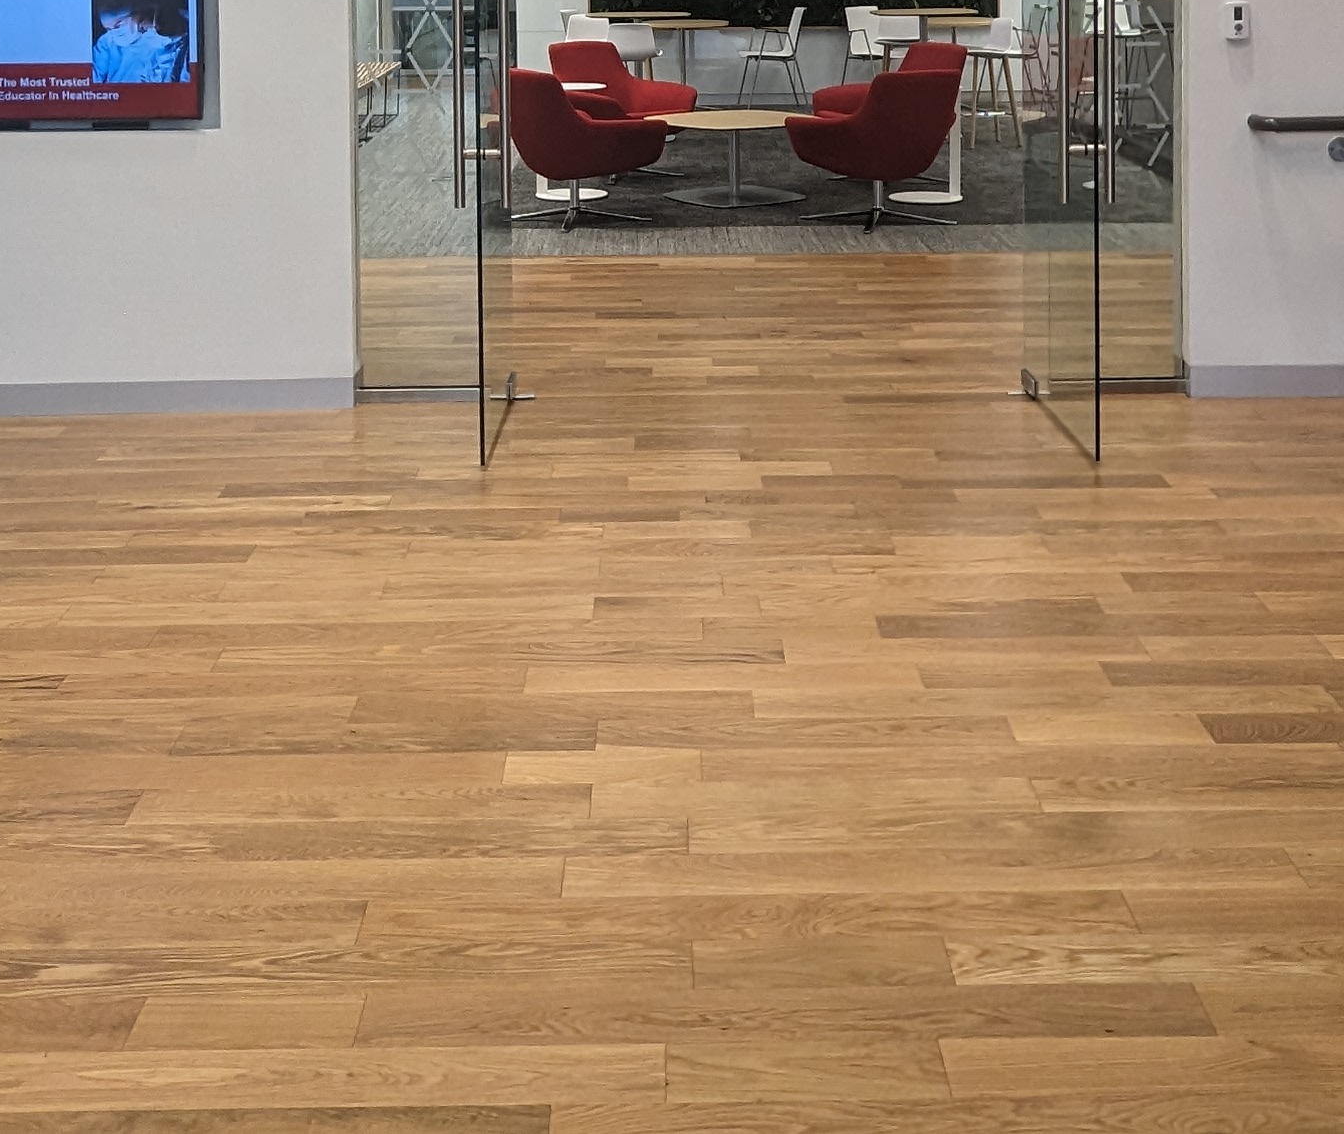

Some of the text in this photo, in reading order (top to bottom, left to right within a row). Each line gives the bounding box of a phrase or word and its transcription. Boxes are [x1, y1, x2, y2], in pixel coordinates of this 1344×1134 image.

[20, 77, 46, 87] Most
[49, 77, 90, 87] Trusted
[49, 91, 59, 100] In
[62, 90, 119, 100] Healthcare
